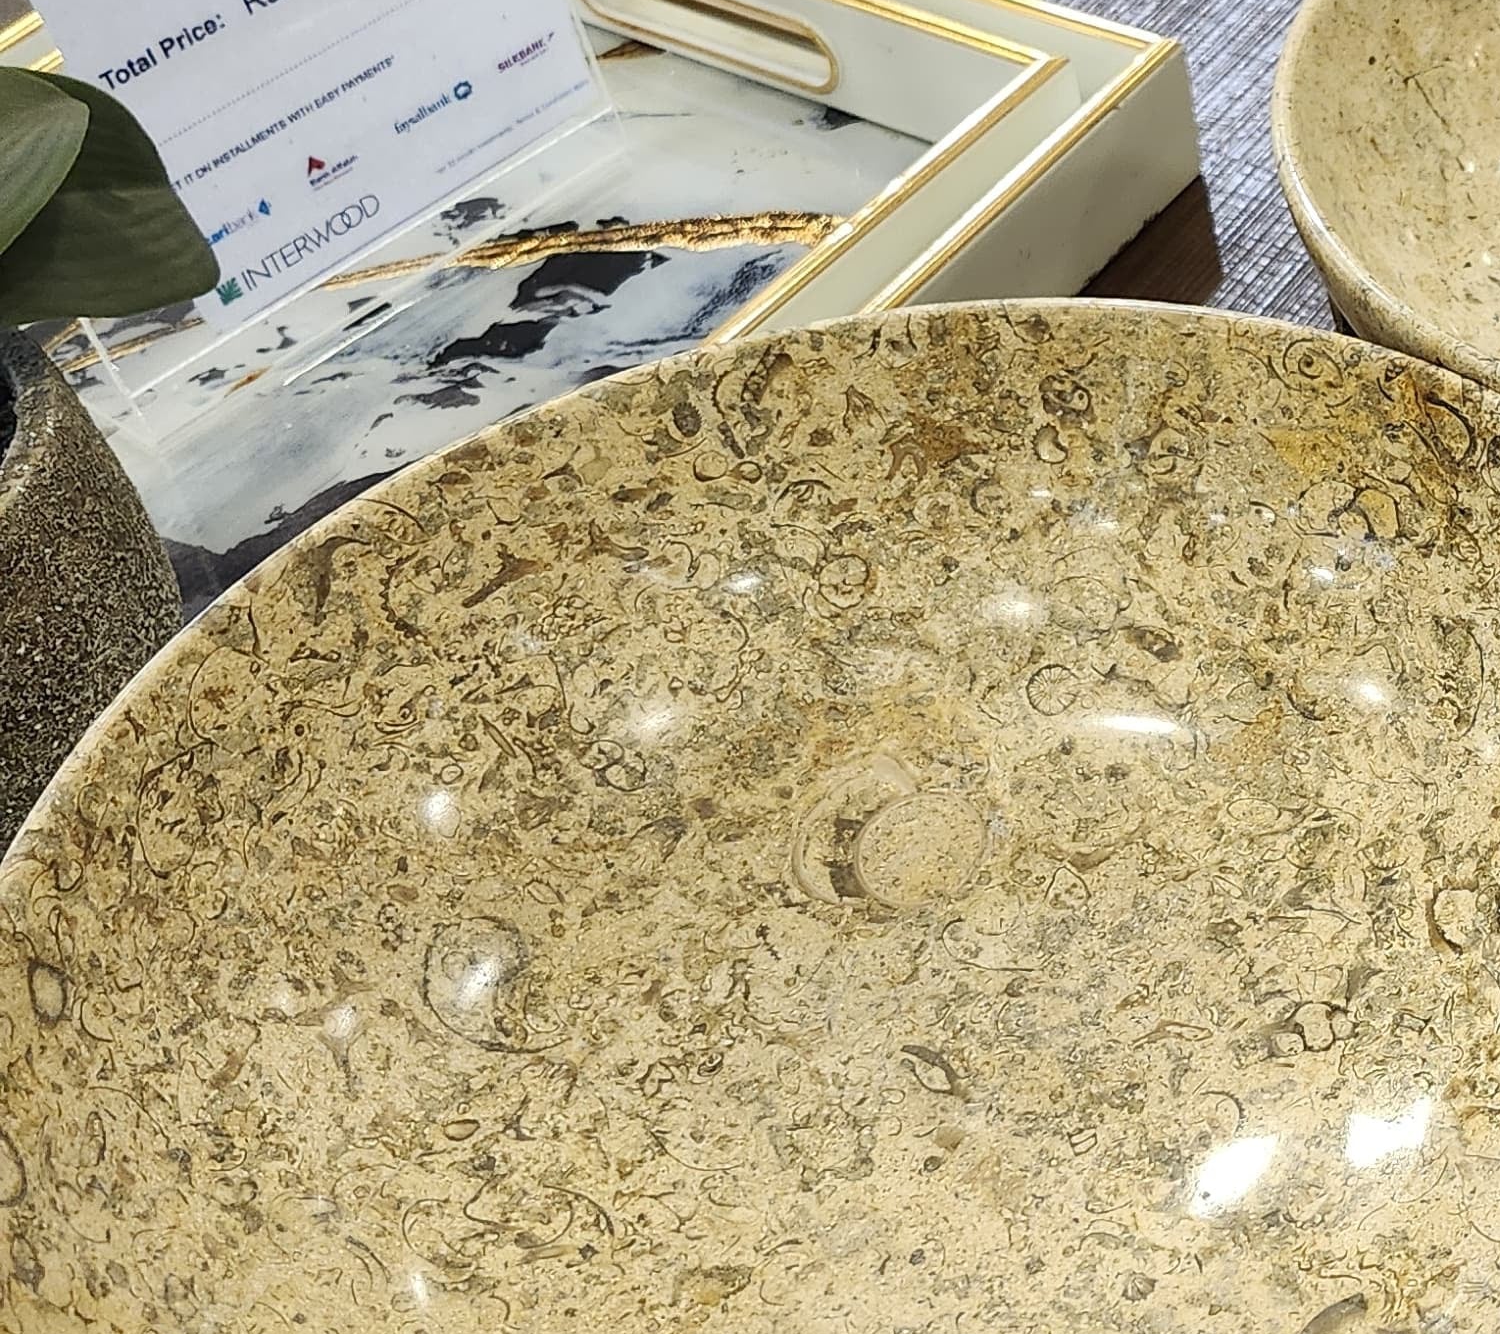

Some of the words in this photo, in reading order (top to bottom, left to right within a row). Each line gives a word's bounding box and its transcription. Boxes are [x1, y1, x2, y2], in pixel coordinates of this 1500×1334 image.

[99, 49, 158, 90] Total
[159, 14, 226, 60] Price:
[195, 163, 212, 180] ON
[212, 120, 287, 168] INSTALLMENTS
[288, 104, 314, 123] WITH
[241, 194, 381, 291] INTERWOOD
